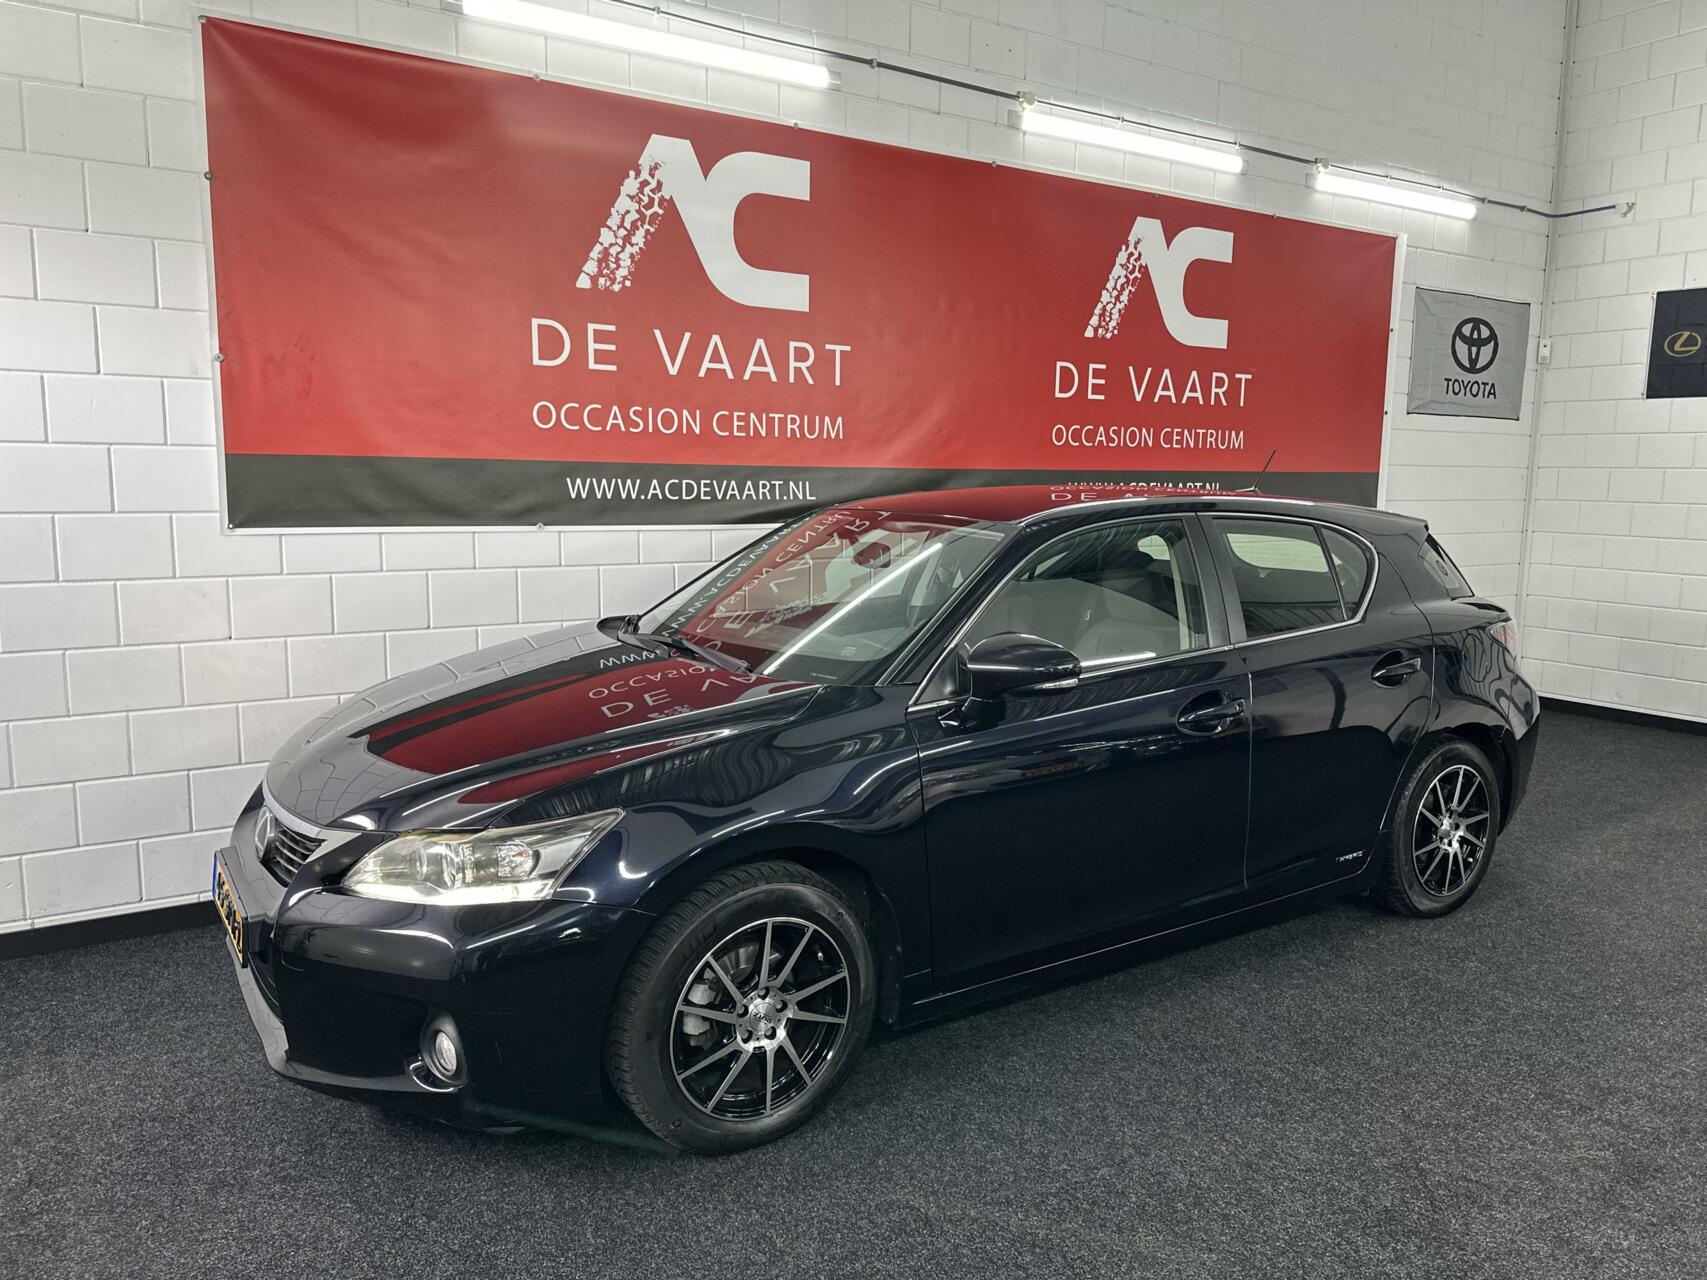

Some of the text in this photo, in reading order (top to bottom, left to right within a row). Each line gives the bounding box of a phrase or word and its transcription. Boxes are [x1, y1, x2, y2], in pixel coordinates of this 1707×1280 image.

[576, 134, 810, 312] AC
[1084, 216, 1234, 349] AC
[531, 318, 851, 386] DE VAART
[1054, 361, 1252, 407] DE VAART
[1444, 377, 1497, 400] TOYOTA
[532, 401, 844, 440] OCCASION CENTRUM
[1052, 424, 1244, 450] OCCASION CENTRUM
[566, 477, 816, 500] WWW.ACDEVAART.NL
